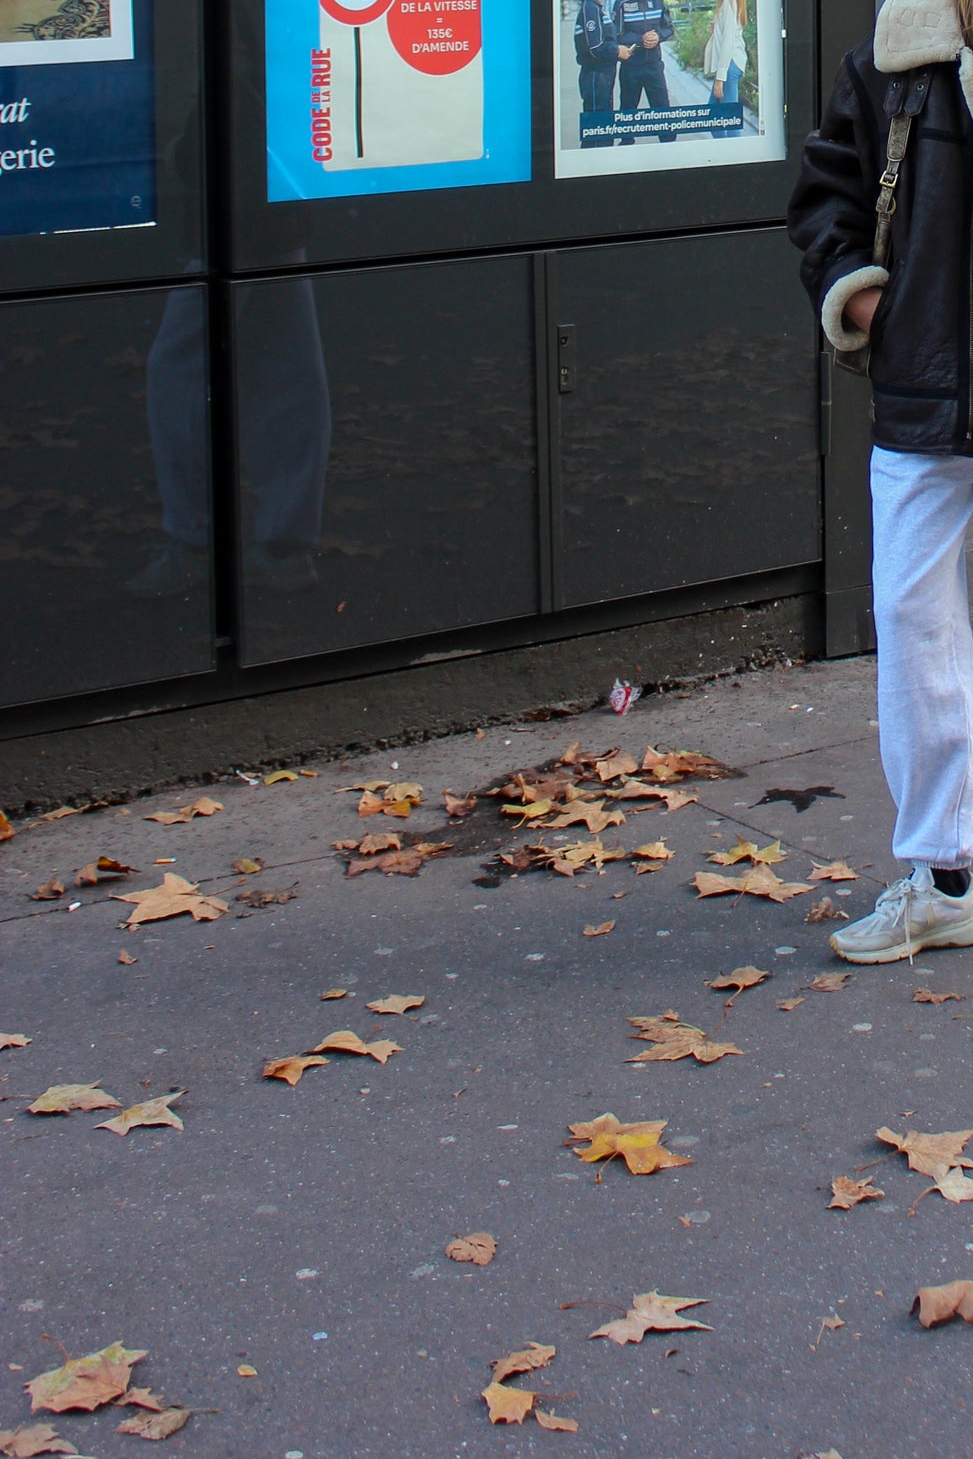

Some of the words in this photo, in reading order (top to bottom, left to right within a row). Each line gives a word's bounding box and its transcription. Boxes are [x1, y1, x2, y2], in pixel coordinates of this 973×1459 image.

[401, 2, 416, 13] DE
[417, 2, 432, 12] LA
[433, 0, 477, 12] VITESSE
[427, 28, 453, 39] 135€
[412, 41, 469, 54] D'AMENDE
[312, 47, 331, 87] RUE
[312, 91, 320, 103] DE
[321, 90, 330, 103] LA
[614, 112, 634, 122] Plus
[634, 108, 697, 121] d'informations
[698, 107, 710, 117] sur
[312, 107, 333, 162] CODE
[0, 140, 55, 177] erie
